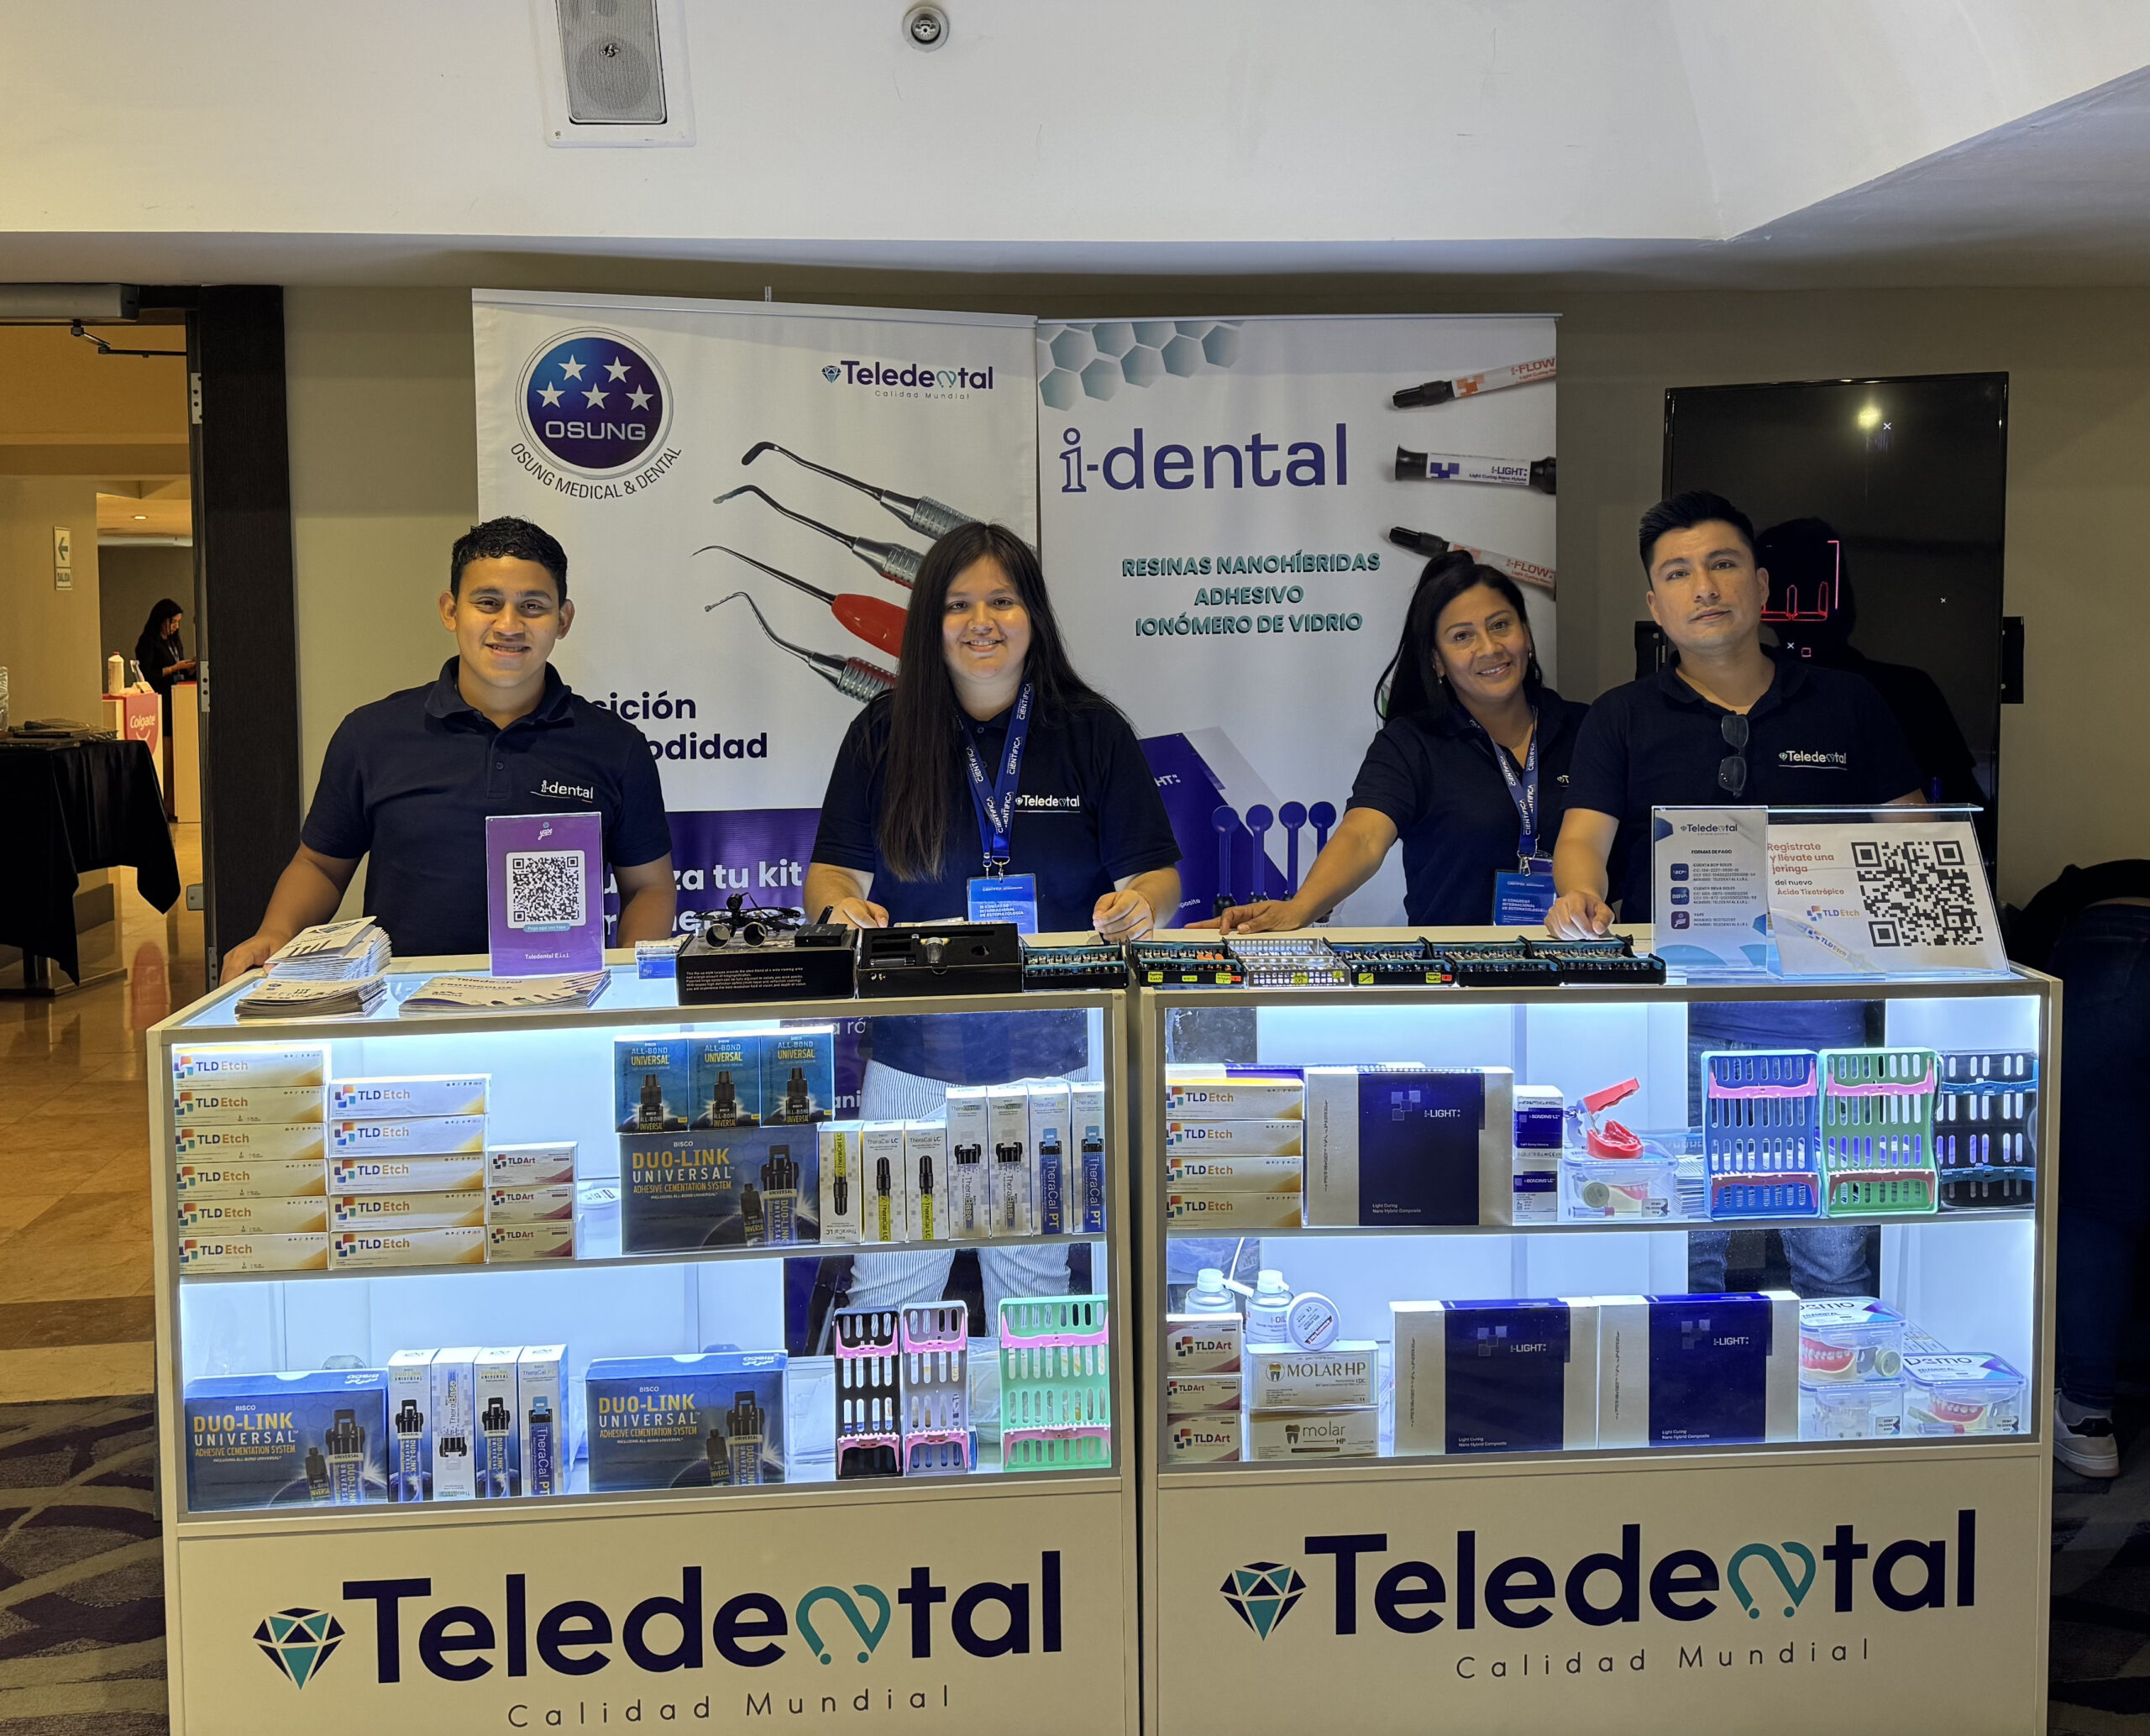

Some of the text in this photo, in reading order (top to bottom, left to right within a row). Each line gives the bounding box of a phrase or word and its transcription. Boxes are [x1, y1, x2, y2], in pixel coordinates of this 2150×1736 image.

[840, 359, 994, 390] Teledental
[874, 390, 919, 398] Calidad
[545, 420, 647, 441] OSUNG
[1060, 422, 1348, 494] i-dental
[511, 443, 682, 500] OSUNG MEDICAL & DENTAL
[1122, 550, 1382, 577] RESINAS NANOHÍBRIDAS
[1194, 585, 1305, 606] ADHESIVO
[1135, 612, 1363, 637] IONÓMERO DE VIDRIO
[130, 715, 156, 730] Colgate
[1786, 750, 1847, 764] Teledental
[1021, 795, 1080, 808] Teledental
[714, 864, 749, 889] tu
[758, 858, 803, 888] kit
[1772, 864, 1808, 874] jeringa
[632, 1046, 668, 1055] ALL-BOND
[778, 1041, 814, 1050] ALL-BOND
[778, 1049, 815, 1060] UNIVERSAL
[632, 1056, 669, 1066] UNIVERSAL
[705, 1052, 742, 1062] UNIVERSAL
[632, 1148, 730, 1169] DUO-LINK
[633, 1181, 732, 1193] ADHESIVE CEMENTATION SYSTEM
[1287, 1361, 1366, 1377] MOLAR HP
[599, 1393, 695, 1413] DUO-LINK
[194, 1412, 294, 1433] DUO-LINK
[1303, 1420, 1345, 1437] molar
[600, 1426, 697, 1439] ADHESIVE CEMENTATION SYSTEM
[195, 1444, 296, 1457] ADHESIVE CEMENTATION SYSTEM
[1303, 1508, 1976, 1636] Teledental
[342, 1550, 1062, 1684] Teledental
[1456, 1638, 1869, 1680] Calidad Mundial
[507, 1684, 950, 1728] Calidad Mundial
